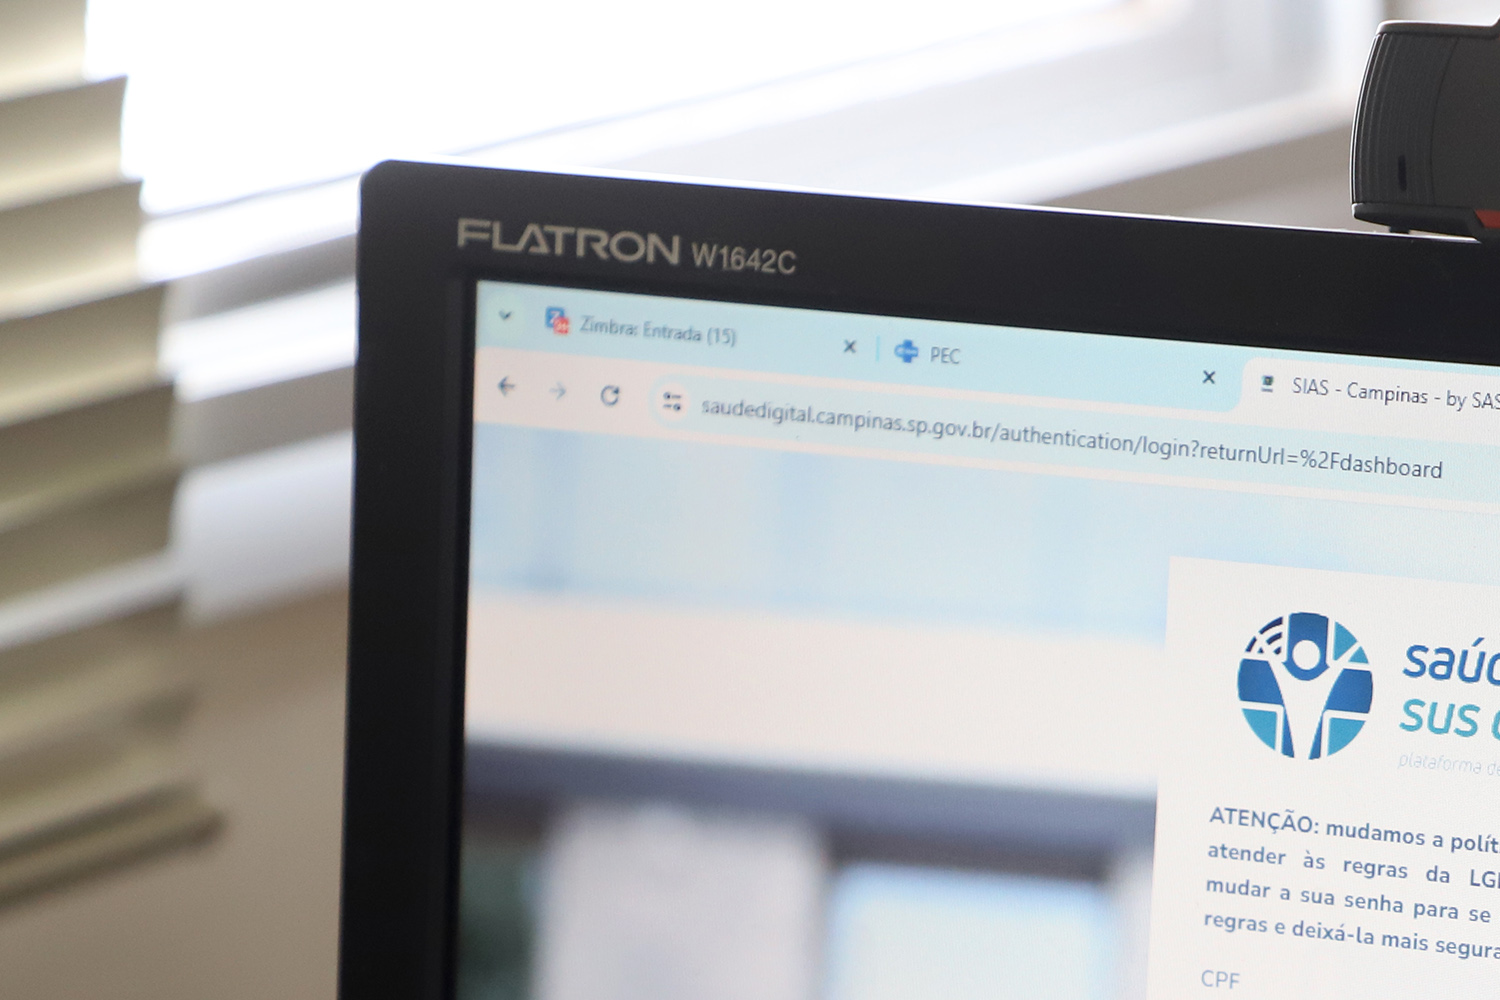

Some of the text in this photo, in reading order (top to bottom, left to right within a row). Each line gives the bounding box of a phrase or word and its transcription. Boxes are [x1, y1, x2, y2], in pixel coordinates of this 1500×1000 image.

[457, 218, 797, 275] FLATRON W1642C
[580, 315, 638, 337] Zimbra:
[643, 322, 702, 342] Entrada
[707, 326, 738, 348] (15)
[930, 346, 961, 364] PEC
[1292, 376, 1330, 396] SIAS
[1346, 382, 1429, 407] Campinas
[1447, 391, 1467, 411] by
[1399, 698, 1481, 738] sus
[1397, 752, 1482, 775] plataforma
[1209, 806, 1320, 835] ATENÇÃO:
[1326, 823, 1426, 846] mudamos
[1432, 835, 1444, 848] a
[1207, 844, 1287, 865] atender
[1303, 850, 1326, 870] às
[1343, 859, 1408, 879] regras
[1426, 865, 1451, 884] da
[1206, 879, 1271, 898] mudar
[1280, 888, 1291, 901] a
[1300, 889, 1335, 906] sua
[1344, 894, 1404, 913] senha
[1413, 902, 1459, 920] para
[1468, 908, 1492, 923] se
[1204, 913, 1268, 933] regras
[1274, 921, 1286, 935] e
[1292, 920, 1375, 945] deixá-la
[1381, 933, 1429, 951] mais
[1200, 969, 1241, 990] CPF
